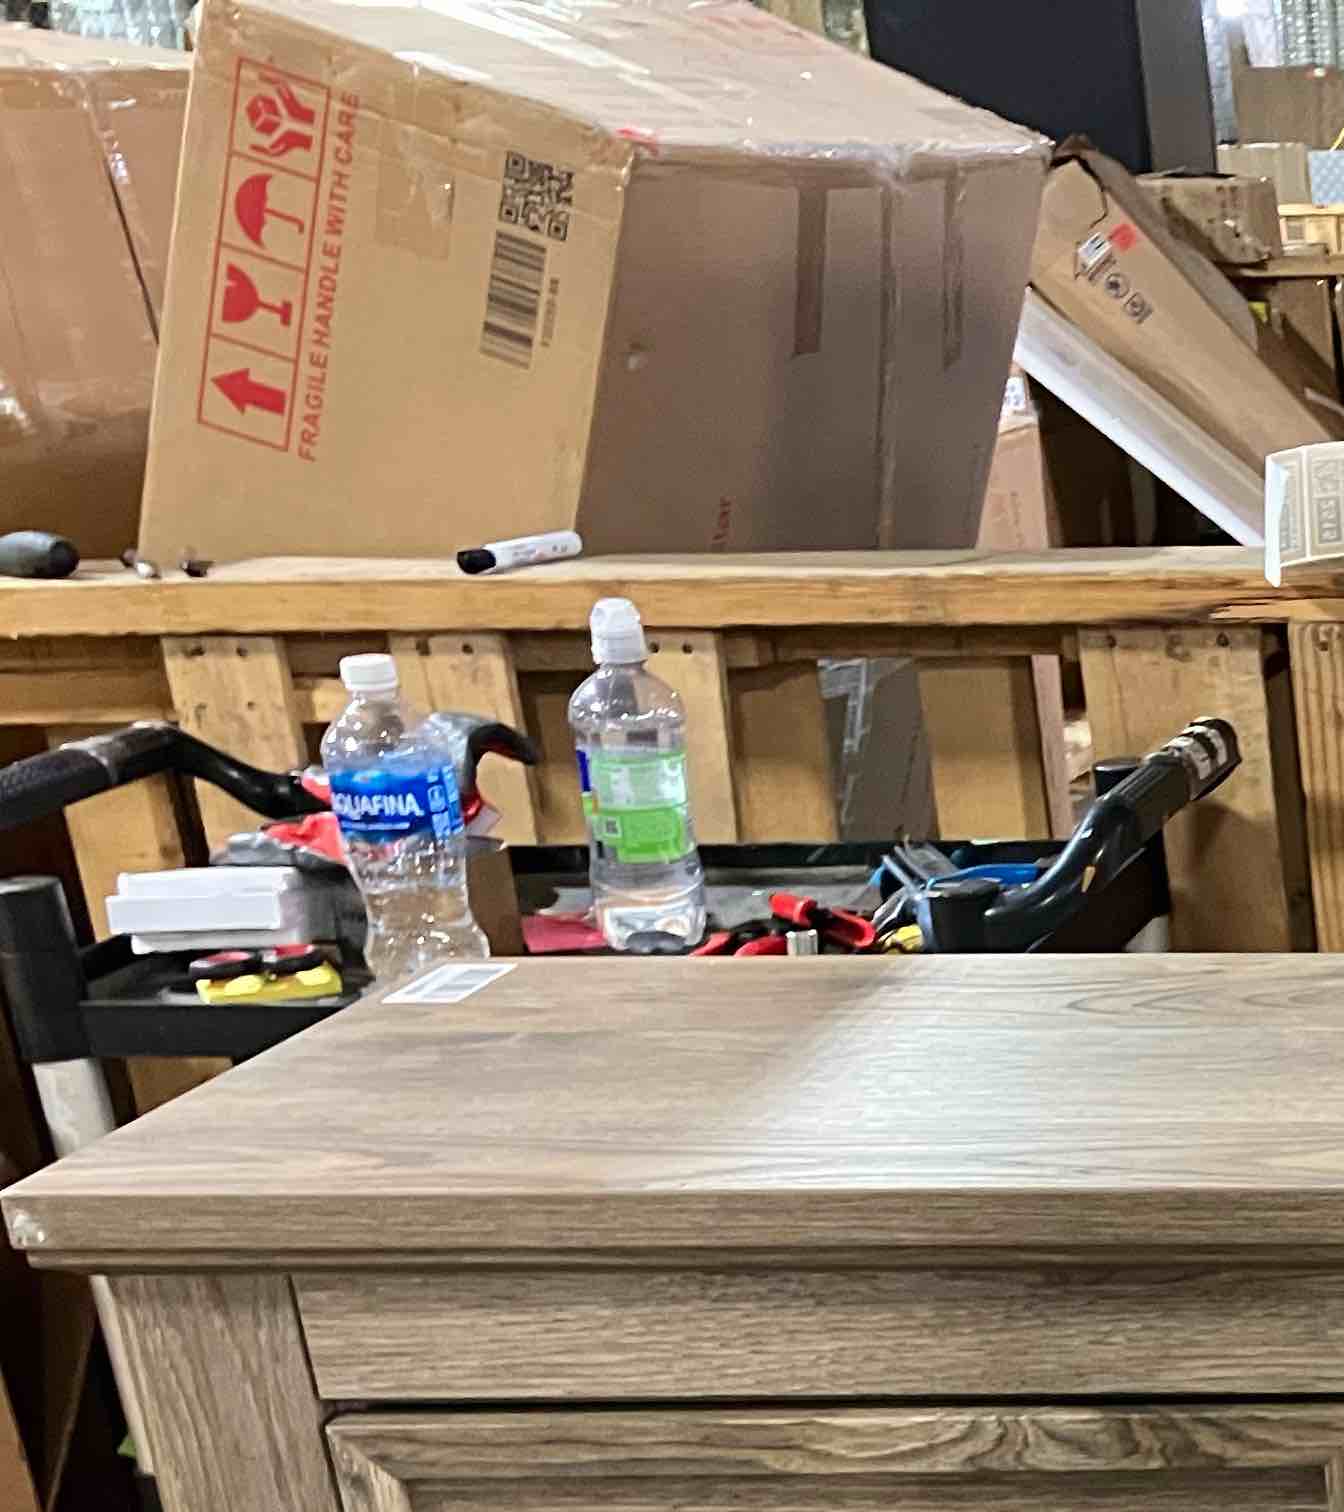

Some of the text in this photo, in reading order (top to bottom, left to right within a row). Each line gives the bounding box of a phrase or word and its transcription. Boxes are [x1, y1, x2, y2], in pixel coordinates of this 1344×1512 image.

[298, 93, 360, 463] FRAGILE HANDLE WITH CARE
